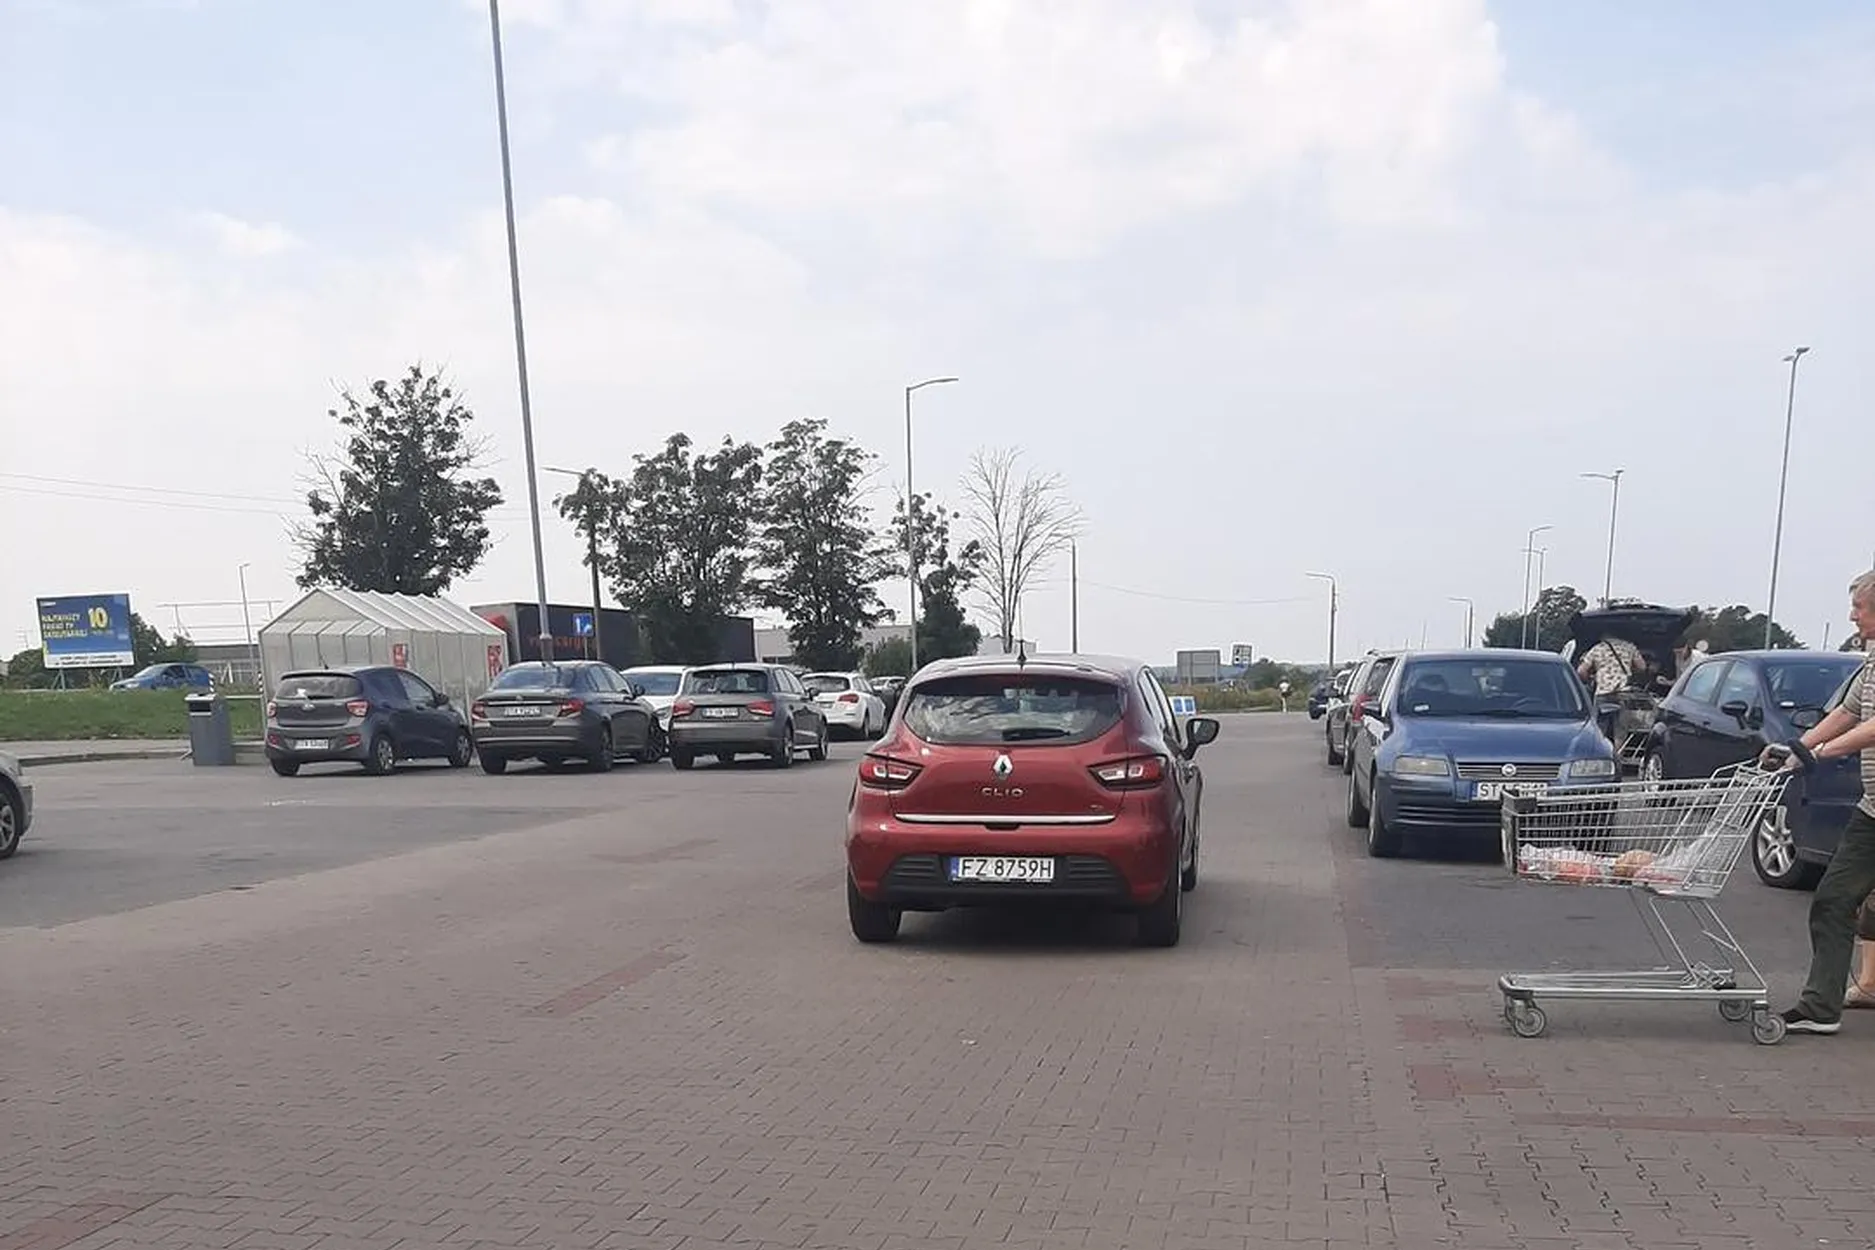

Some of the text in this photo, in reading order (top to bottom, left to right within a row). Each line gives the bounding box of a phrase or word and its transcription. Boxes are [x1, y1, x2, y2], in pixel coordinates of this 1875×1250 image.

[88, 607, 108, 628] 10
[982, 786, 1024, 797] CLIO
[962, 859, 1052, 878] FZ 8759H
